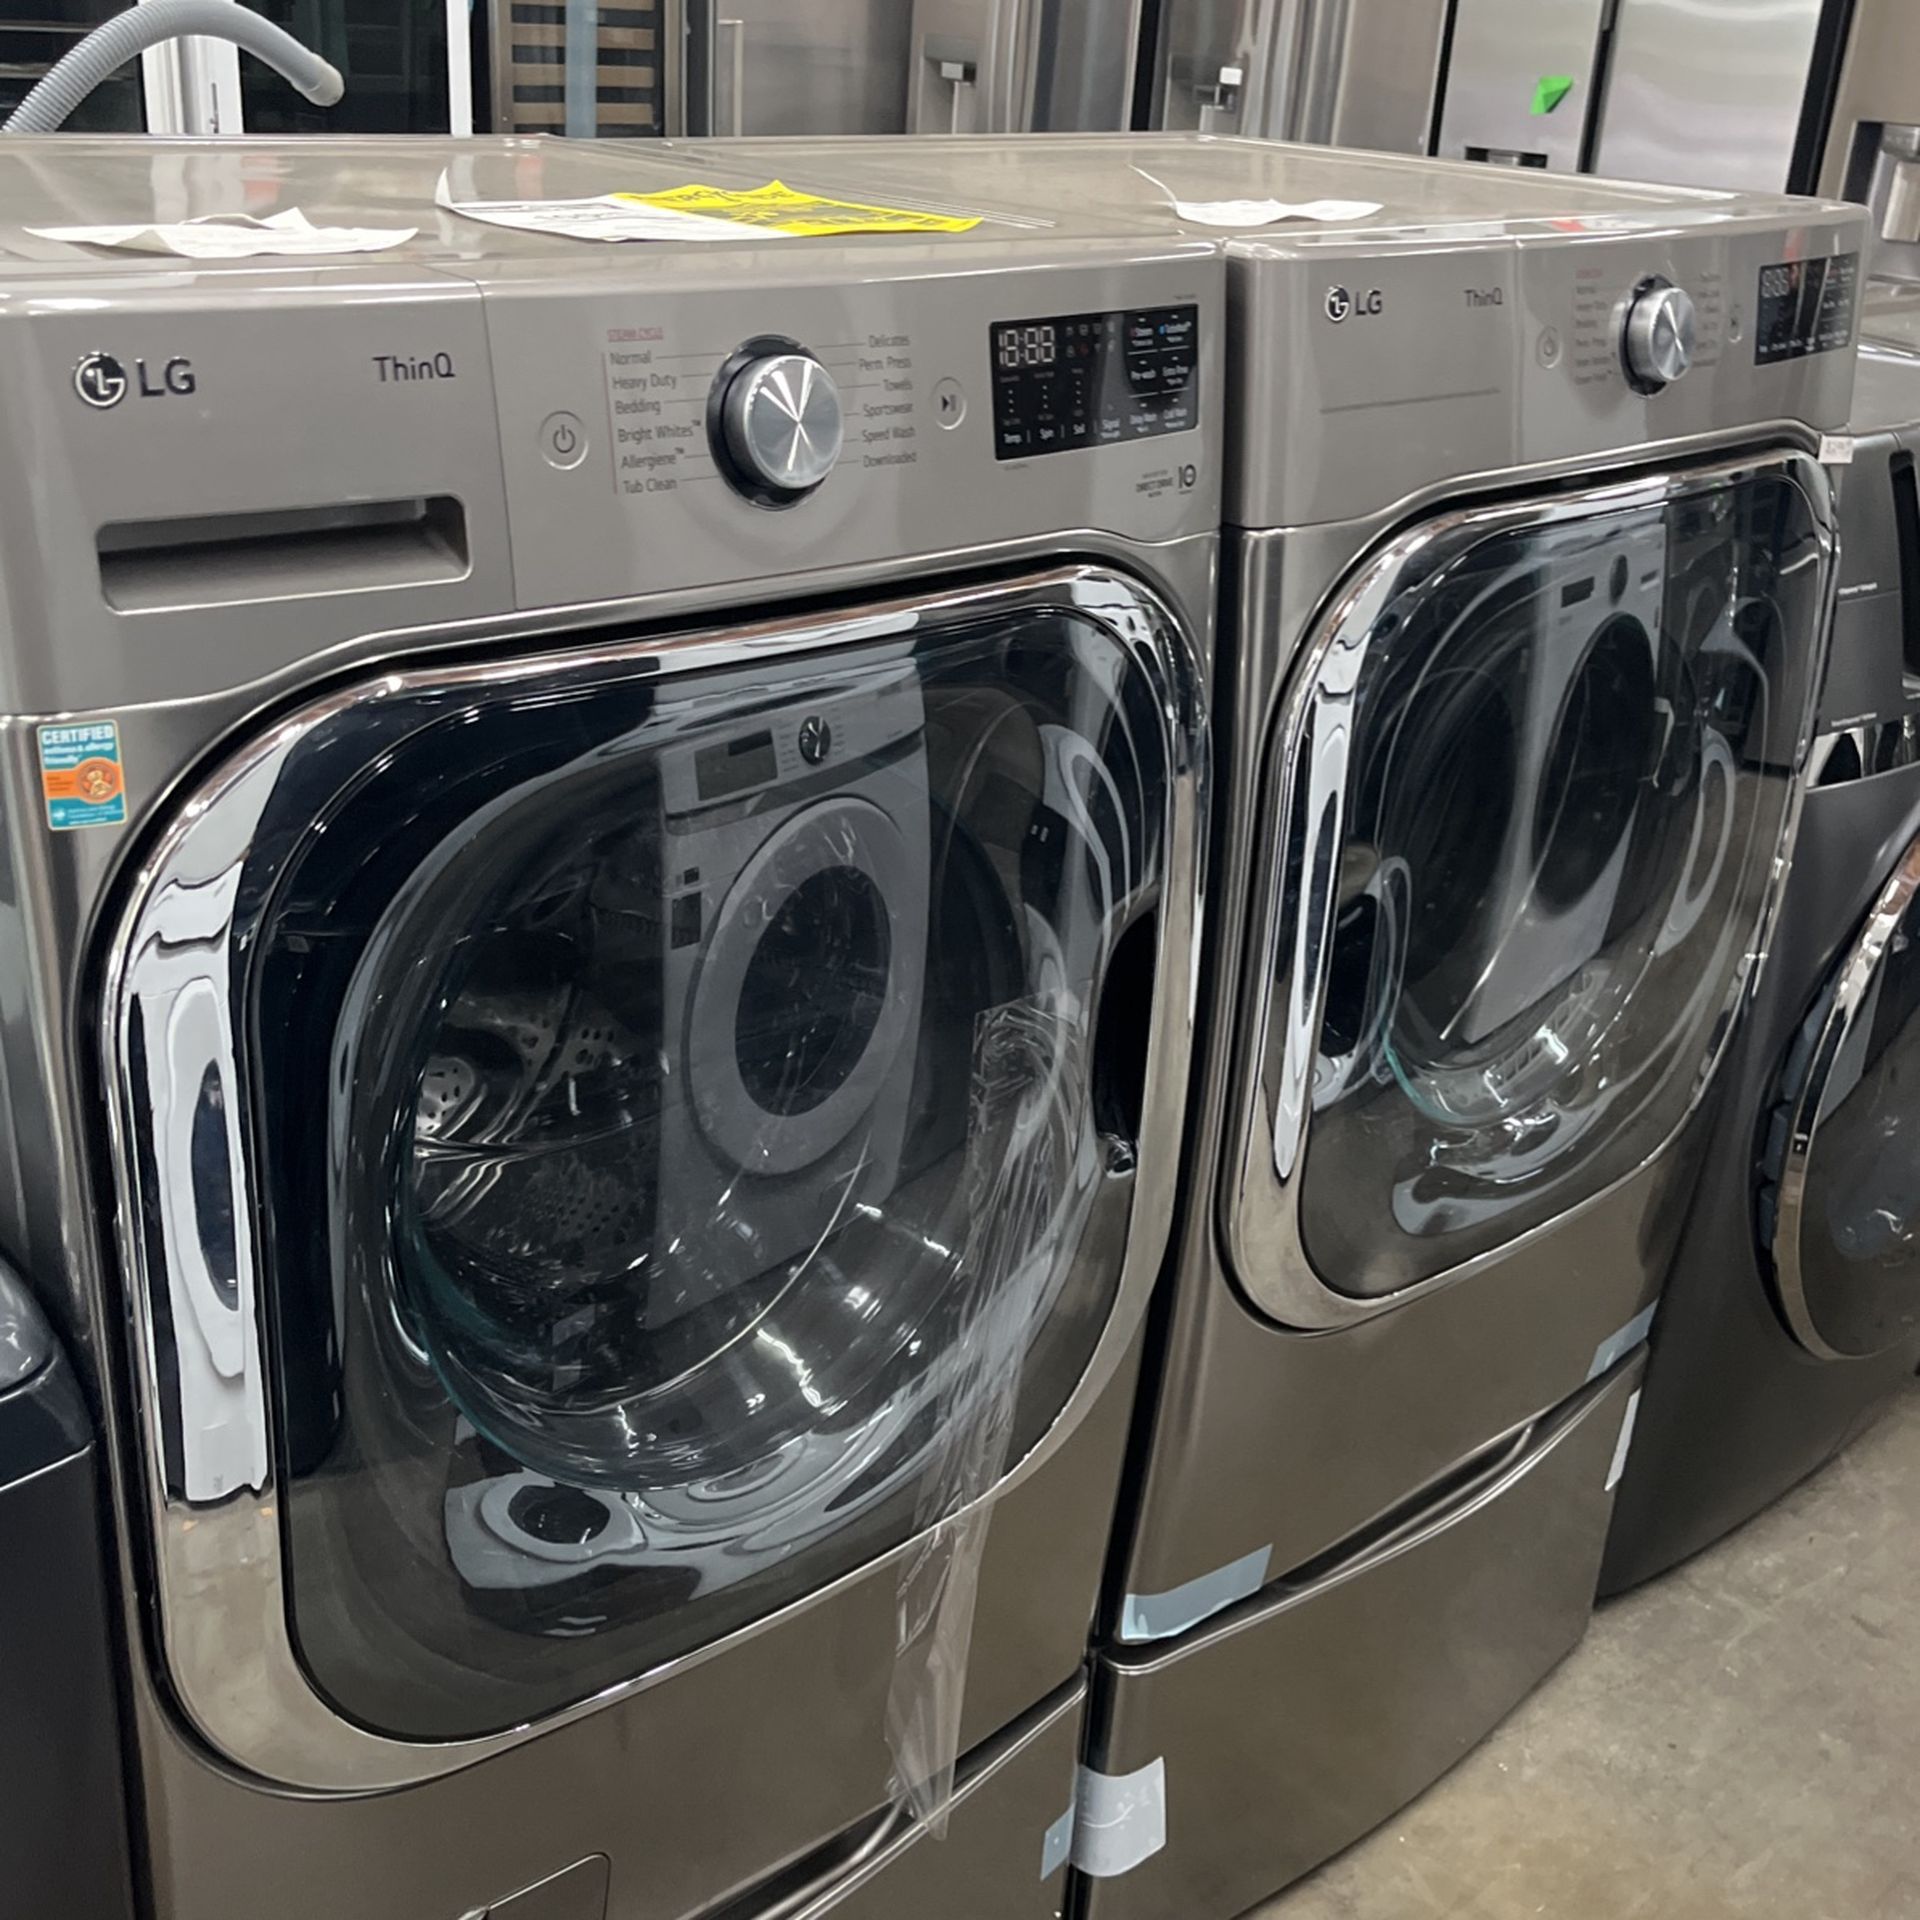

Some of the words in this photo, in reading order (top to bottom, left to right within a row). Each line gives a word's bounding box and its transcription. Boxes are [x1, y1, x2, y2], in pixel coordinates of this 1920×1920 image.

[1355, 290, 1383, 316] LG
[1464, 287, 1503, 307] ThinQ
[609, 350, 652, 364] Normal
[135, 356, 196, 397] LG
[371, 352, 455, 382] ThinQ
[611, 377, 647, 391] Heavy
[650, 373, 678, 389] Duty
[615, 399, 660, 415] Bedding
[617, 427, 653, 444] Bright
[623, 480, 643, 493] Tub
[646, 478, 678, 491] Clean
[42, 725, 115, 745] CERTIFIED
